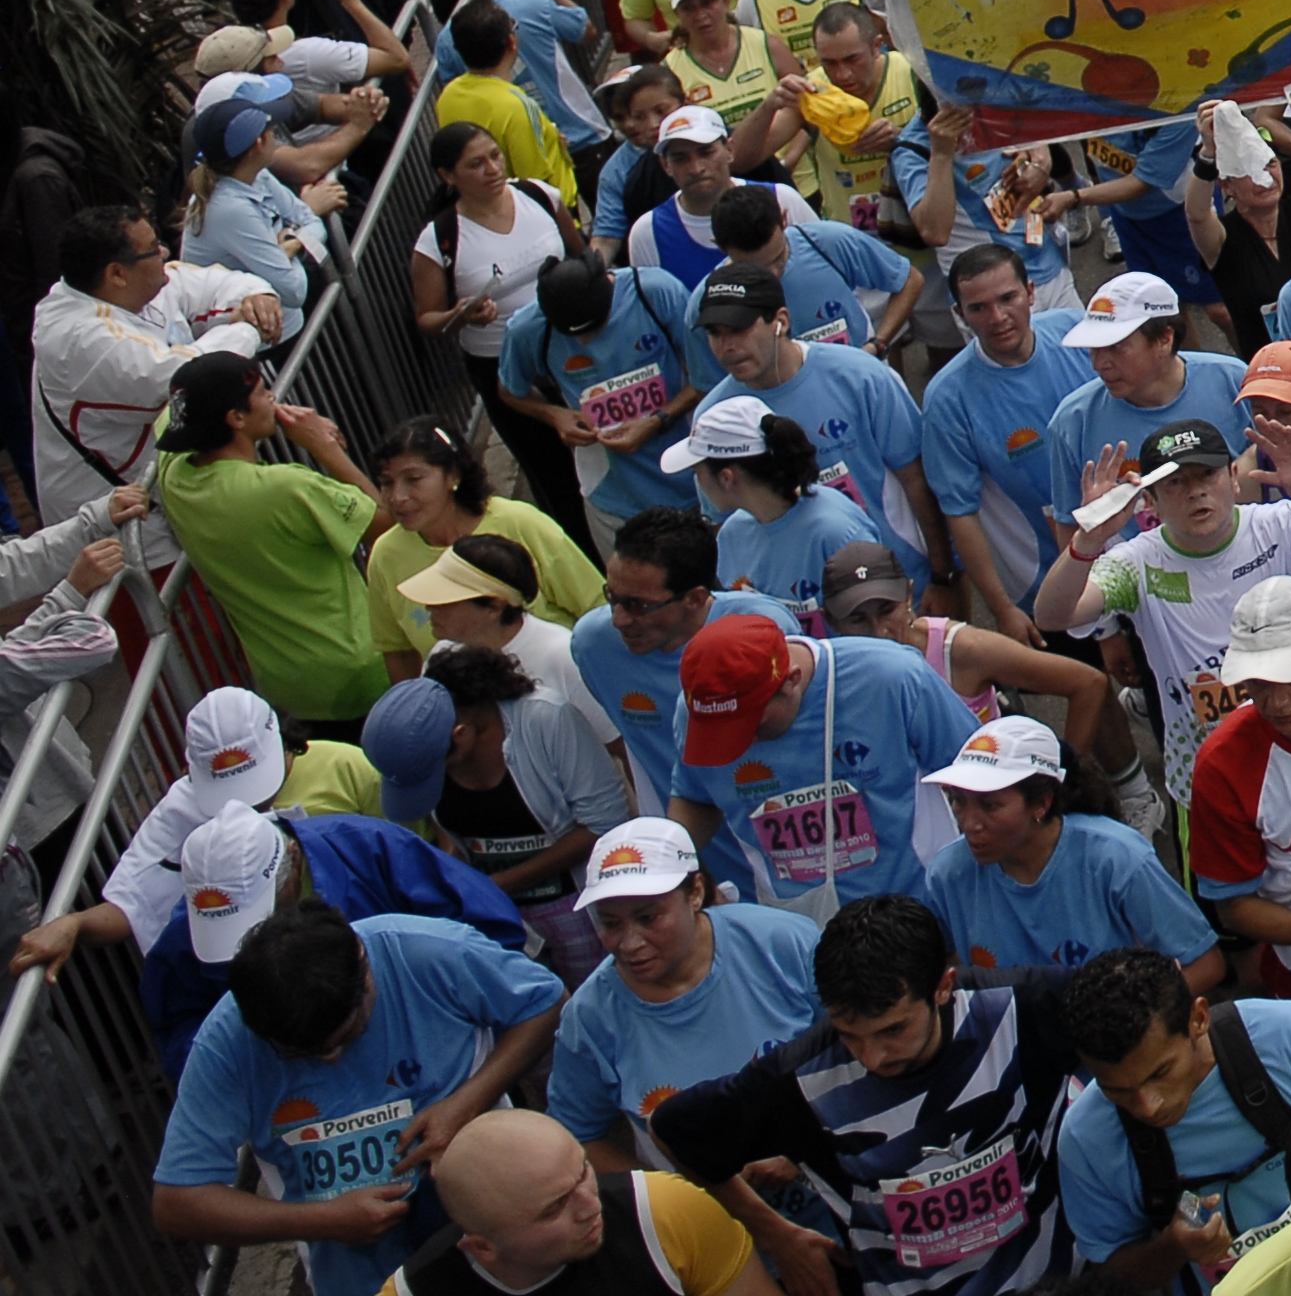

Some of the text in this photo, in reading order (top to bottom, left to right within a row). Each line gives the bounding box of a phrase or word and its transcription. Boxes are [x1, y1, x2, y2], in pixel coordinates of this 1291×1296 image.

[708, 284, 746, 294] NOKIA
[802, 324, 842, 341] orvenir
[607, 365, 659, 391] Porvenir
[590, 380, 666, 428] 26826
[708, 442, 751, 454] Porvenir
[1174, 430, 1201, 447] FSL
[785, 781, 851, 807] Porvnir
[484, 835, 546, 853] Porvenir
[323, 1104, 401, 1139] Porvenir
[302, 1130, 402, 1194] 39503
[929, 1142, 1005, 1186] Porvenir
[896, 1165, 1013, 1234] 26956
[1231, 1223, 1280, 1257] Porve
